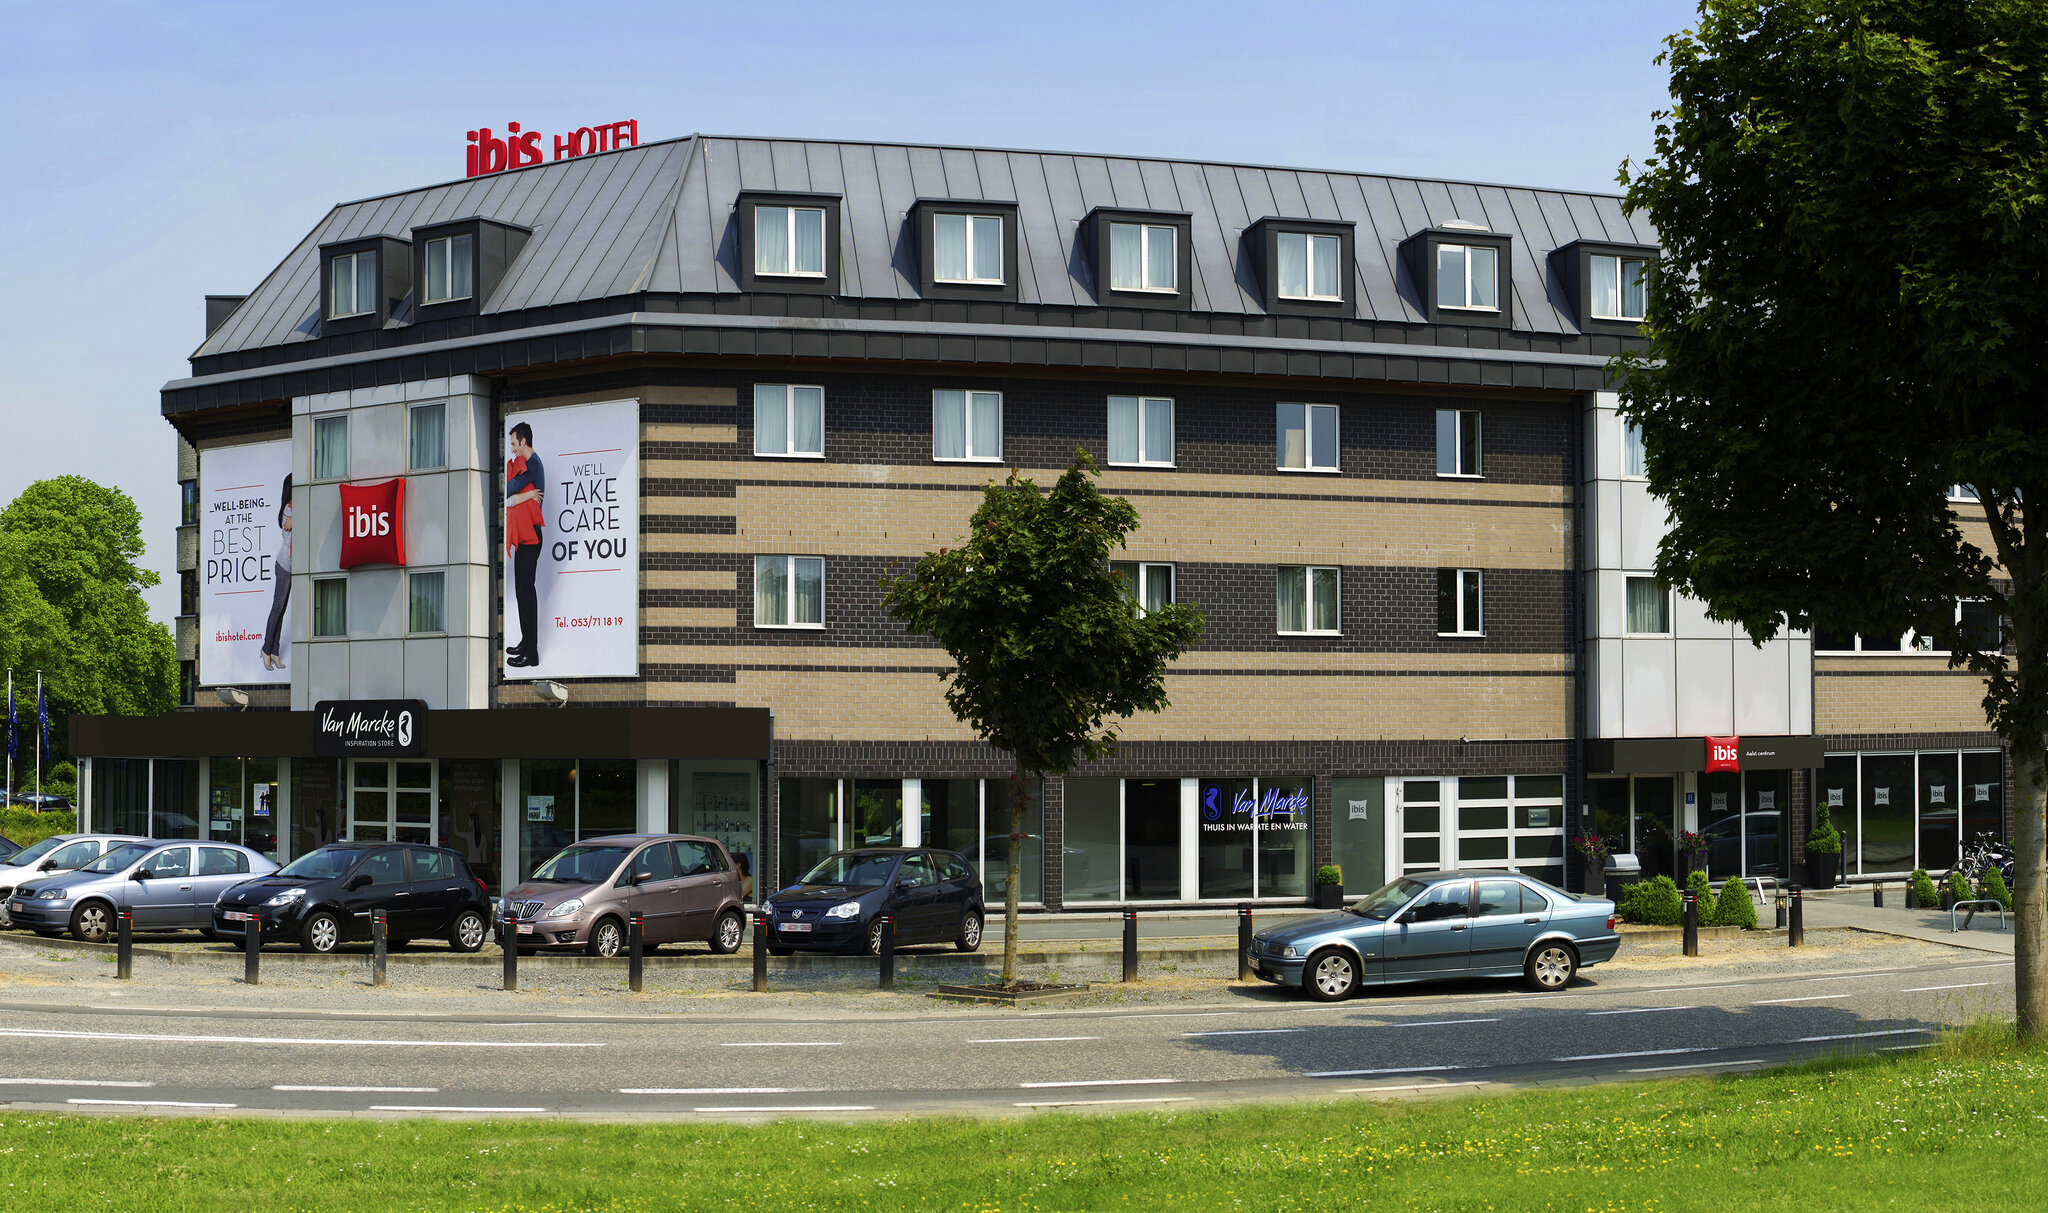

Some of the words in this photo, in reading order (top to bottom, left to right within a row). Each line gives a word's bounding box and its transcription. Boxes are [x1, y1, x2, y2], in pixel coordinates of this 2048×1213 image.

[466, 121, 544, 178] ibis
[572, 463, 606, 476] WE'LL
[561, 478, 618, 505] TAKE
[225, 514, 236, 525] AT
[237, 512, 253, 524] THE
[349, 504, 390, 538] ibis
[558, 505, 620, 533] CARE
[213, 525, 266, 555] BEST
[552, 540, 579, 562] OF
[584, 537, 627, 560] YOU
[207, 555, 272, 585] PRICE
[554, 616, 569, 628] Tel.
[571, 615, 601, 628] 053/71
[603, 616, 612, 627] 18
[614, 616, 624, 626] 19
[215, 629, 263, 642] ibishotel.com
[322, 707, 344, 737] Van
[346, 710, 395, 739] Marcke
[1713, 745, 1738, 761] ibis
[1830, 792, 1841, 801] ibis
[1876, 791, 1887, 800] ibis
[1933, 789, 1943, 797] ibis
[1977, 787, 1987, 796] ibis
[1232, 787, 1256, 818] Van
[1259, 787, 1308, 819] Marcke
[1713, 796, 1725, 805] ibis
[1351, 804, 1364, 813] ibis
[1203, 823, 1225, 831] THUIS
[1226, 823, 1236, 831] IN
[1271, 822, 1282, 830] EN
[1283, 822, 1308, 830] WATER
